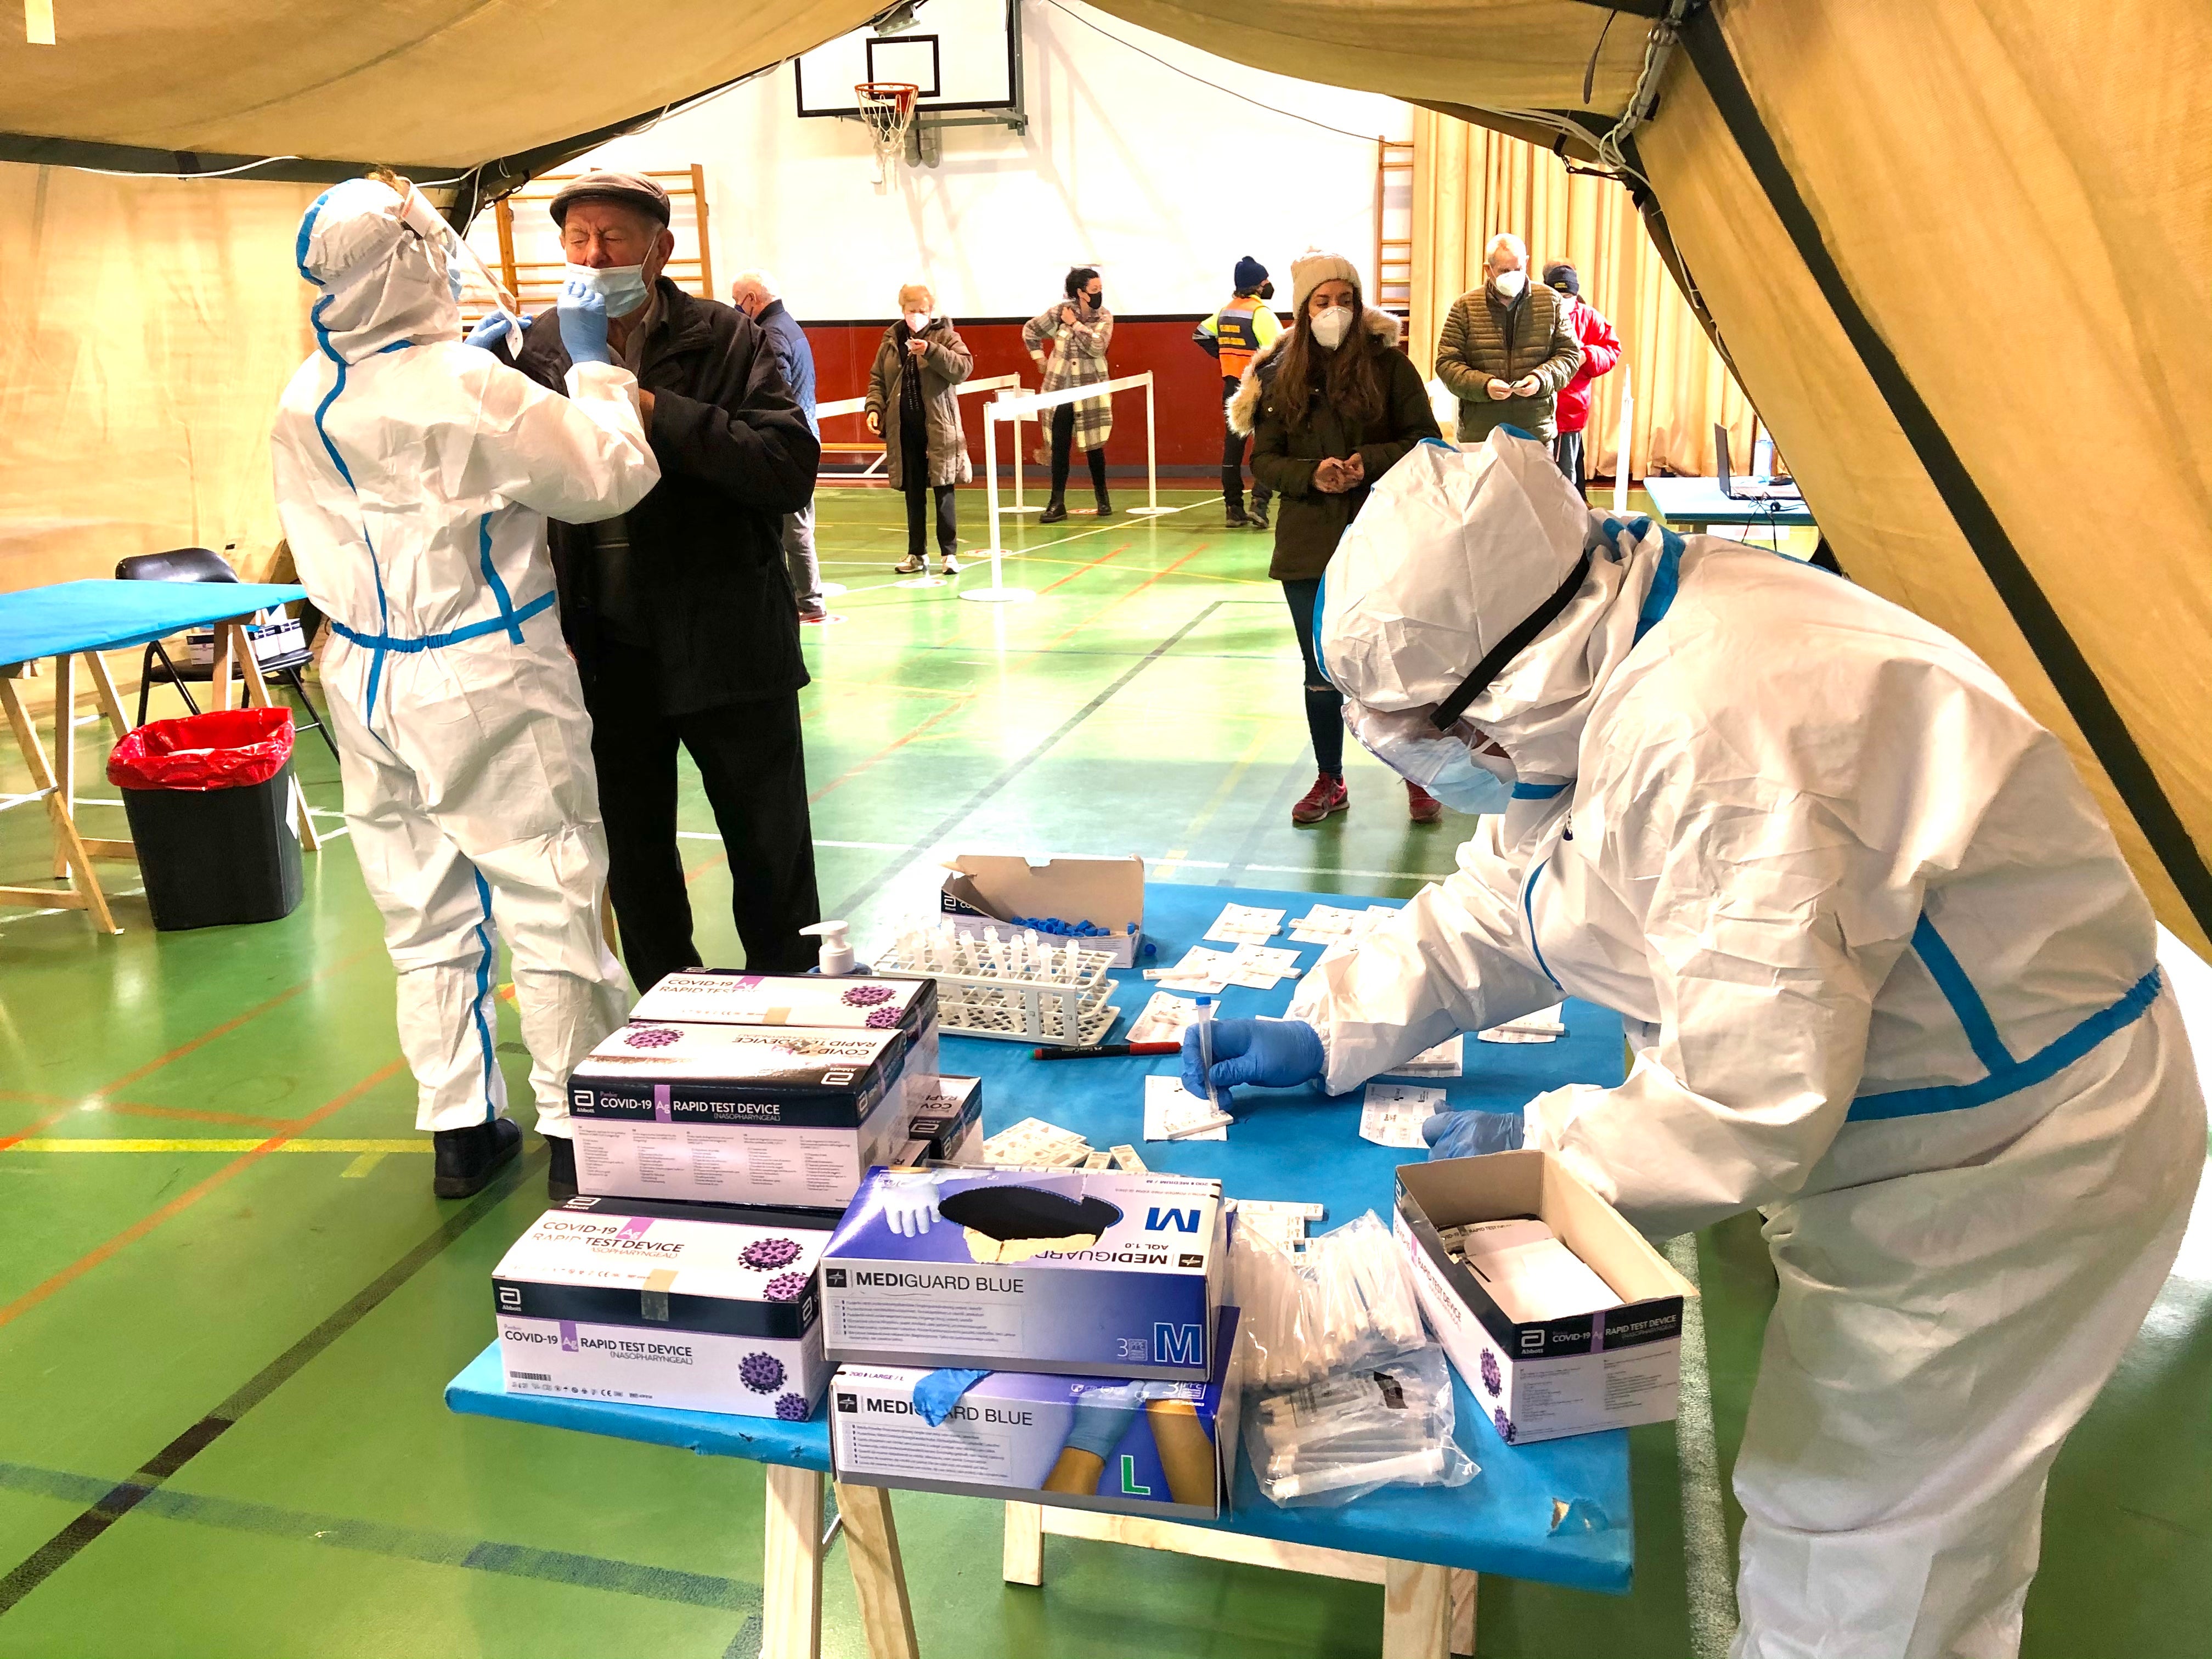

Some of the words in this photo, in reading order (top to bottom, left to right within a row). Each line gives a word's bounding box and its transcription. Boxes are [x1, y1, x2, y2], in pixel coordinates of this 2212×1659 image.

[600, 1098, 652, 1109] COVID-19
[656, 1101, 670, 1114] Ag
[673, 1101, 708, 1112] RAPID
[710, 1102, 735, 1113] TEST
[737, 1103, 780, 1114] DEVICE
[543, 1222, 617, 1234] COVID-19
[1144, 1207, 1201, 1233] M
[586, 1237, 621, 1247] TEST
[622, 1240, 685, 1252] DEVICE
[856, 1272, 969, 1290] MEDIGUARD
[976, 1278, 1024, 1293] BLUE
[1553, 1333, 1591, 1343] COVID-19
[1605, 1325, 1629, 1336] RAPID
[1630, 1321, 1649, 1331] TEST
[1649, 1314, 1677, 1328] DEVICE
[505, 1330, 558, 1344] COVID-19
[580, 1338, 617, 1350] RAPID
[619, 1341, 645, 1352] TEST
[648, 1344, 692, 1357] DEVICE
[1154, 1322, 1202, 1364] M
[611, 1351, 693, 1365] (NASOPHARYNGEAL)
[985, 1409, 1032, 1426] BLUE
[1121, 1454, 1150, 1495] L
